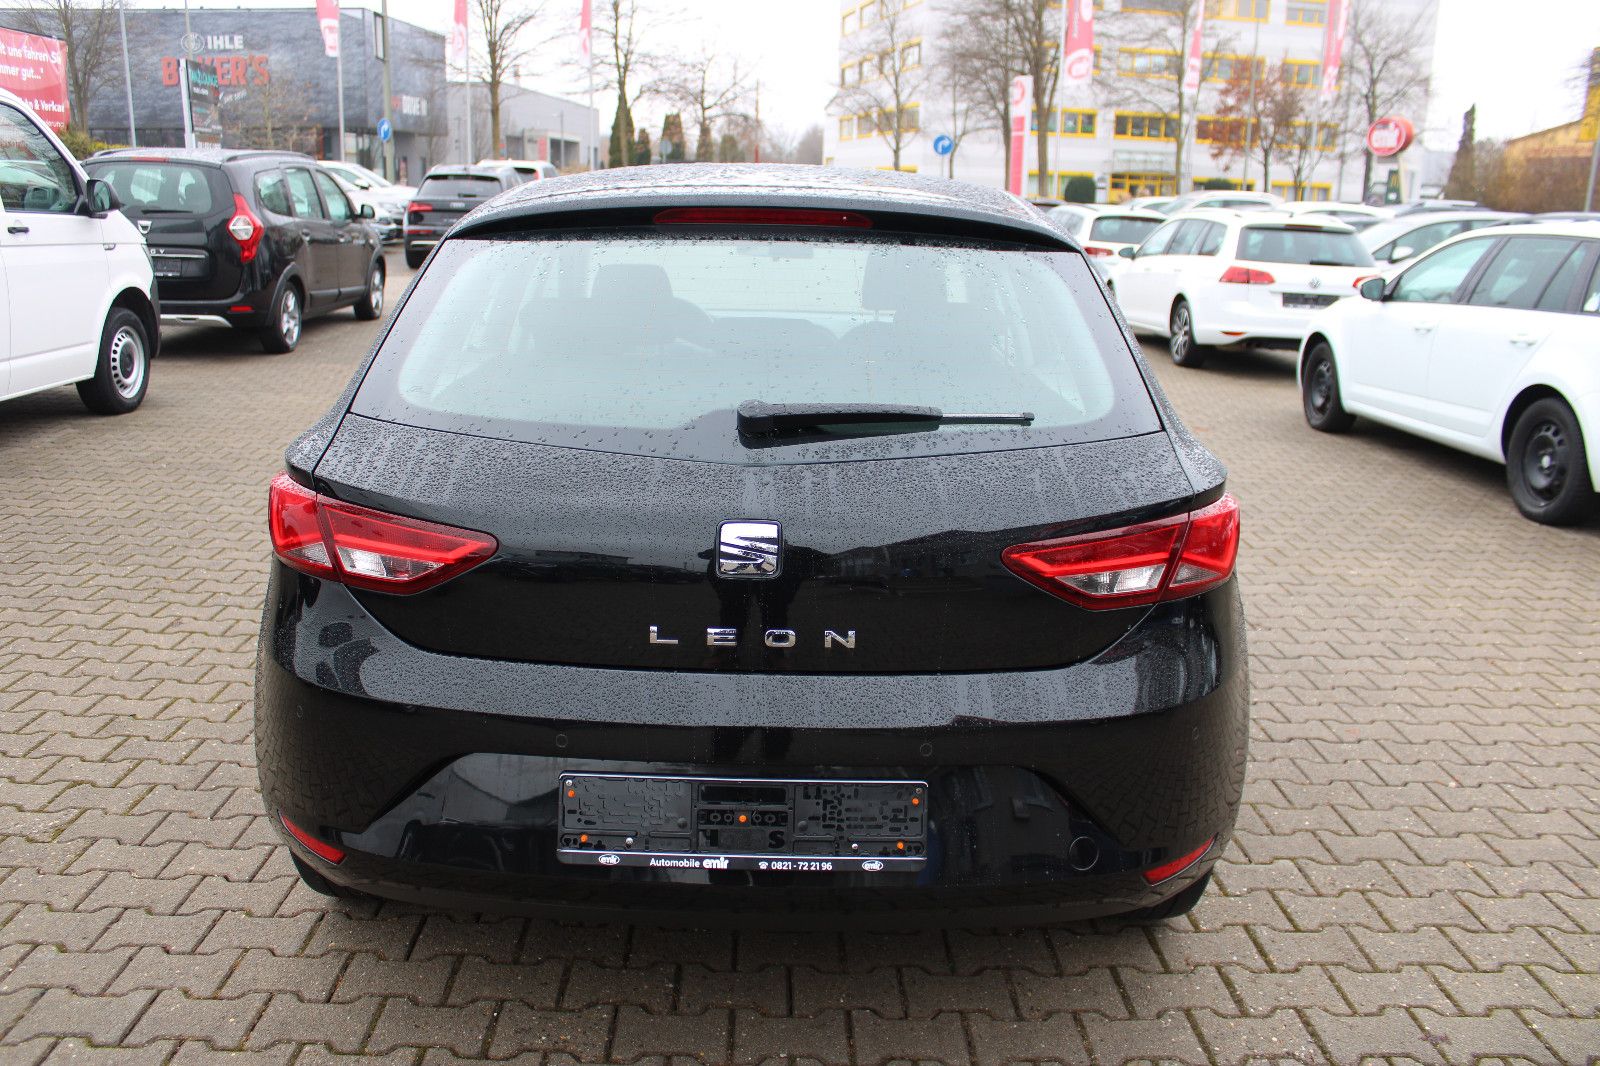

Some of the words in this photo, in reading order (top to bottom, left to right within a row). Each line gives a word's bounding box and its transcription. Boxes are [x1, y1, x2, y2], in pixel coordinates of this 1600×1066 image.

[207, 35, 244, 50] IHLE
[7, 46, 23, 58] uns
[22, 45, 49, 62] fahren
[160, 54, 270, 88] BER'S
[649, 625, 856, 649] LEON
[599, 855, 619, 865] emir
[649, 857, 700, 868] Automobile
[702, 857, 729, 869] emir
[771, 861, 792, 870] 0821
